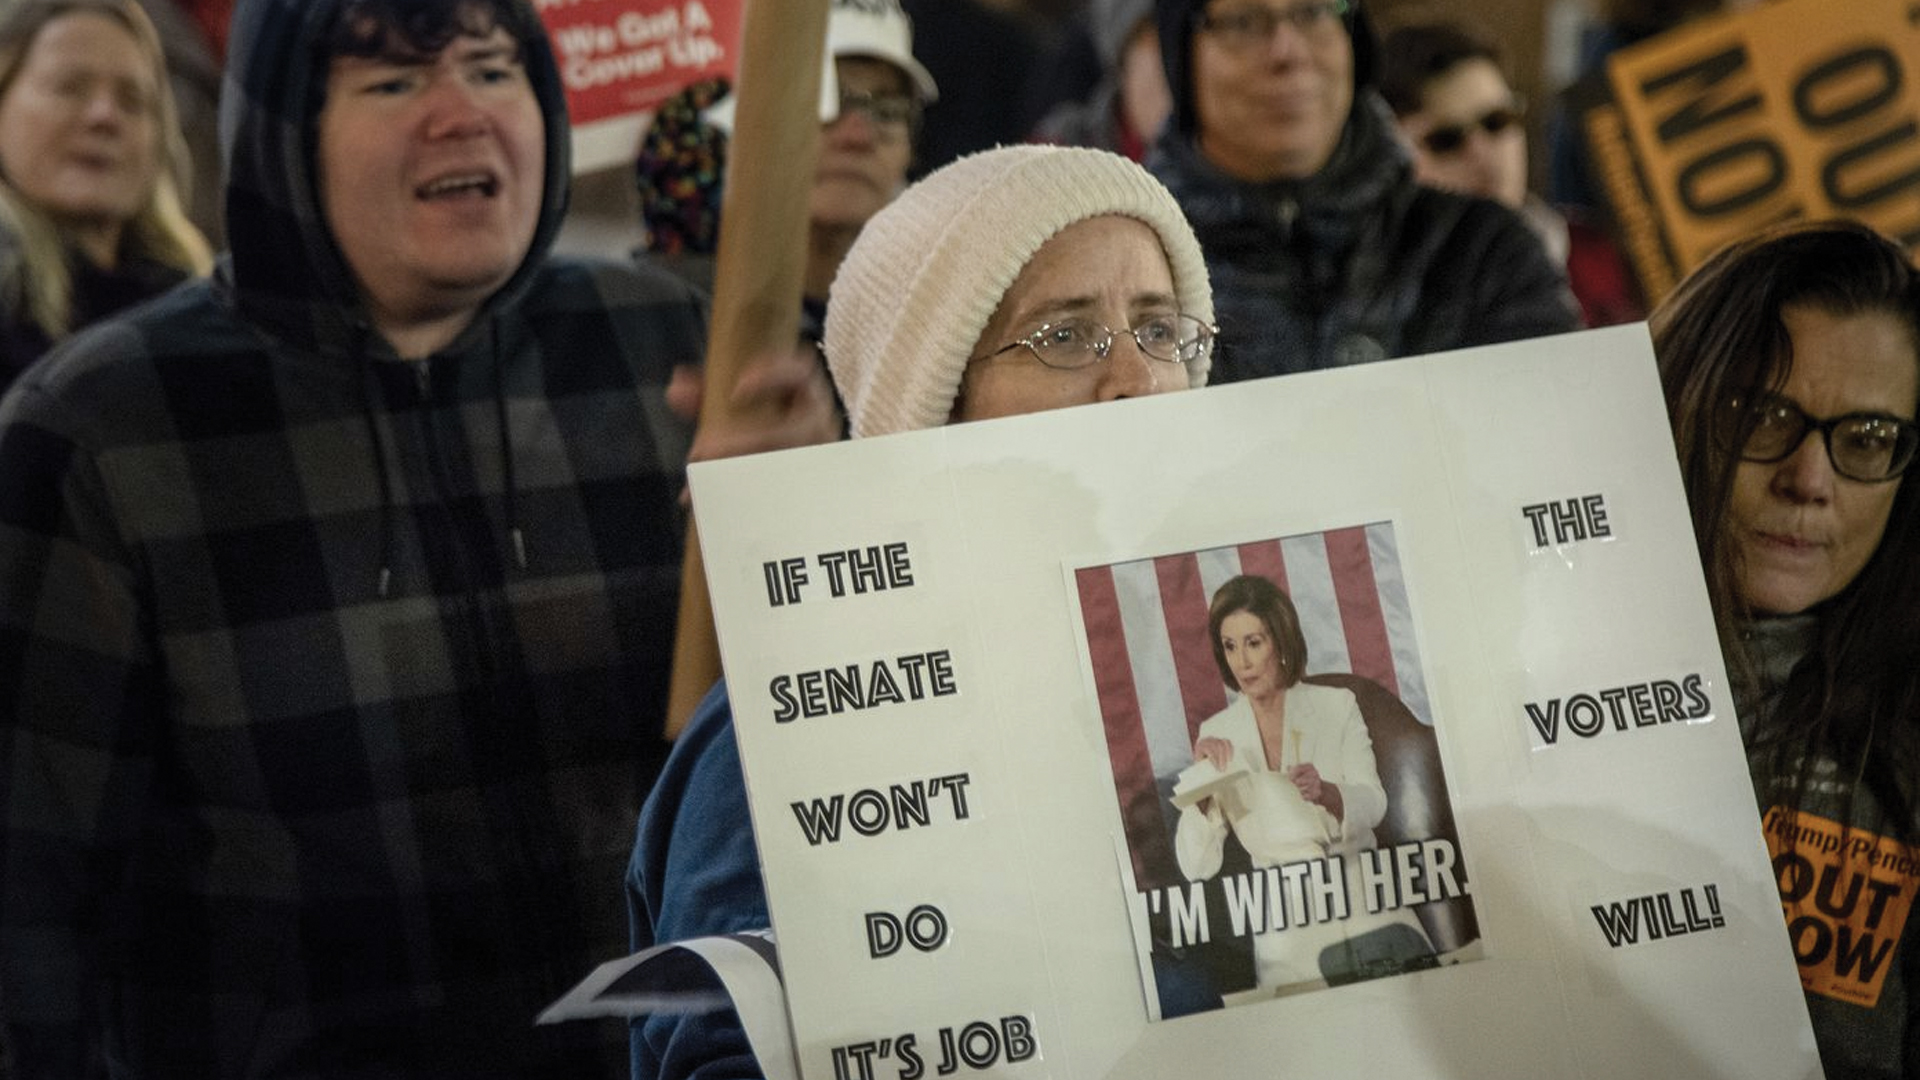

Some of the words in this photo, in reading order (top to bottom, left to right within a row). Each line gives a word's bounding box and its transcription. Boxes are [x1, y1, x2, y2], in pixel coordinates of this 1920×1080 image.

[685, 1, 713, 31] A
[1641, 44, 1805, 222] NO
[1794, 47, 1920, 250] OU
[1522, 494, 1612, 548] THE
[763, 557, 809, 608] IF
[817, 542, 914, 598] THE
[769, 649, 957, 724] SENATE
[1524, 673, 1712, 745] VOTERS
[790, 772, 970, 846] WON'T
[1140, 882, 1211, 950] I'M
[1222, 854, 1349, 938] WITH
[1359, 838, 1471, 915] HER.
[1591, 883, 1725, 948] WILL!
[1772, 851, 1901, 931] OUT
[864, 904, 949, 959] DO
[1784, 908, 1894, 984] OW
[831, 1033, 926, 1080] IT'S
[937, 1014, 1036, 1076] JOB
